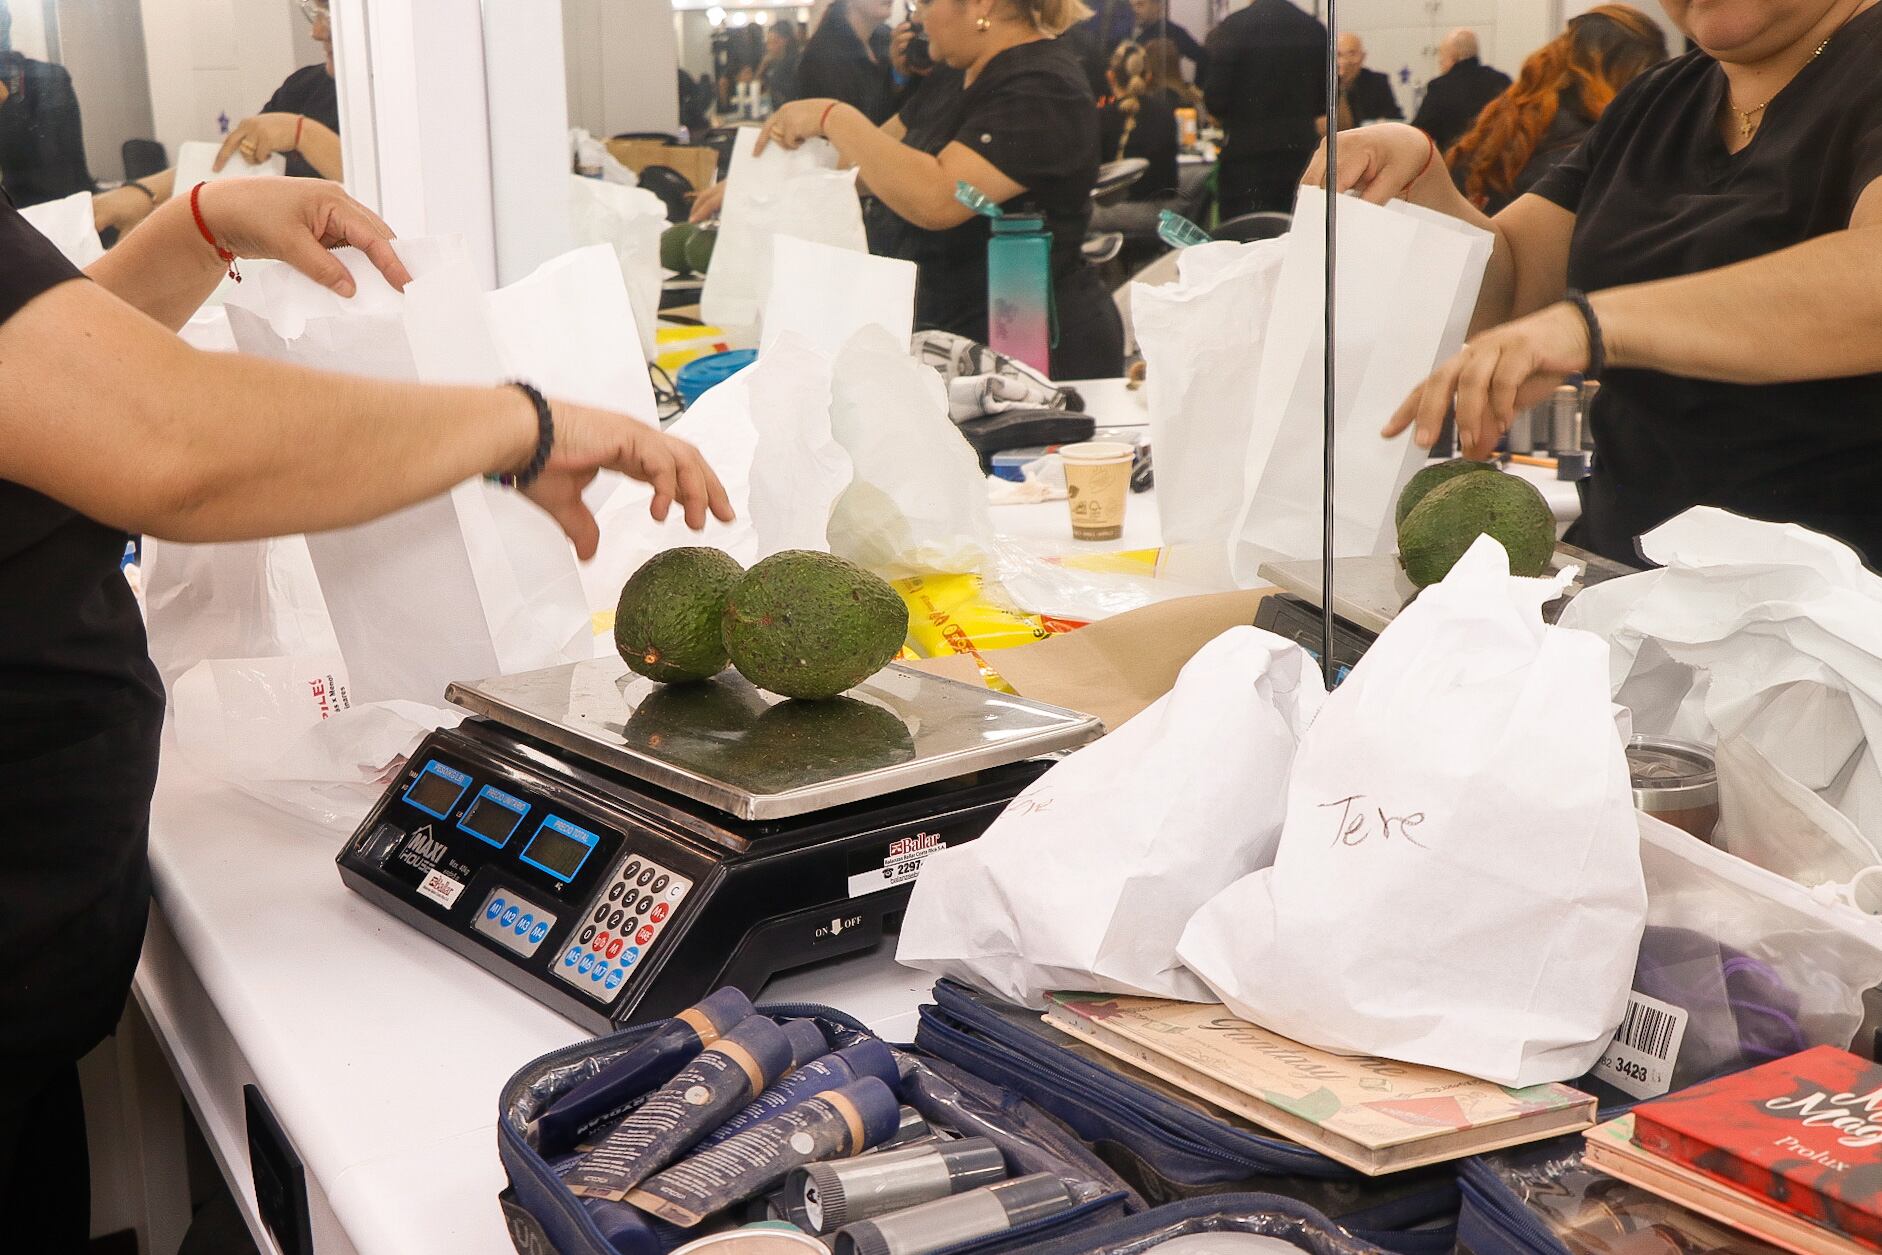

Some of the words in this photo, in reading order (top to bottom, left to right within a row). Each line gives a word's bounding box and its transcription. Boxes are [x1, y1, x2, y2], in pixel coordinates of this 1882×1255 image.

[1317, 794, 1431, 850] Tere
[408, 832, 448, 864] MAXI
[901, 833, 940, 855] Ballar
[627, 865, 637, 875] 7
[641, 872, 651, 882] 8
[655, 879, 665, 889] 9
[670, 886, 680, 896] C
[613, 887, 622, 898] 4
[625, 893, 635, 903] 5
[640, 900, 649, 910] 6
[651, 906, 665, 919] M+
[489, 902, 502, 914] M1
[502, 910, 517, 924] M2
[516, 918, 531, 931] M3
[530, 926, 545, 938] M4
[599, 908, 607, 918] 1
[611, 915, 621, 926] 2
[624, 921, 634, 932] 3
[815, 926, 829, 938] ON
[844, 916, 862, 928] OFF
[566, 950, 580, 962] M5
[580, 957, 593, 971] M6
[593, 965, 607, 977] M7
[1616, 1057, 1648, 1082] 3423
[1773, 1136, 1850, 1172] Prolux
